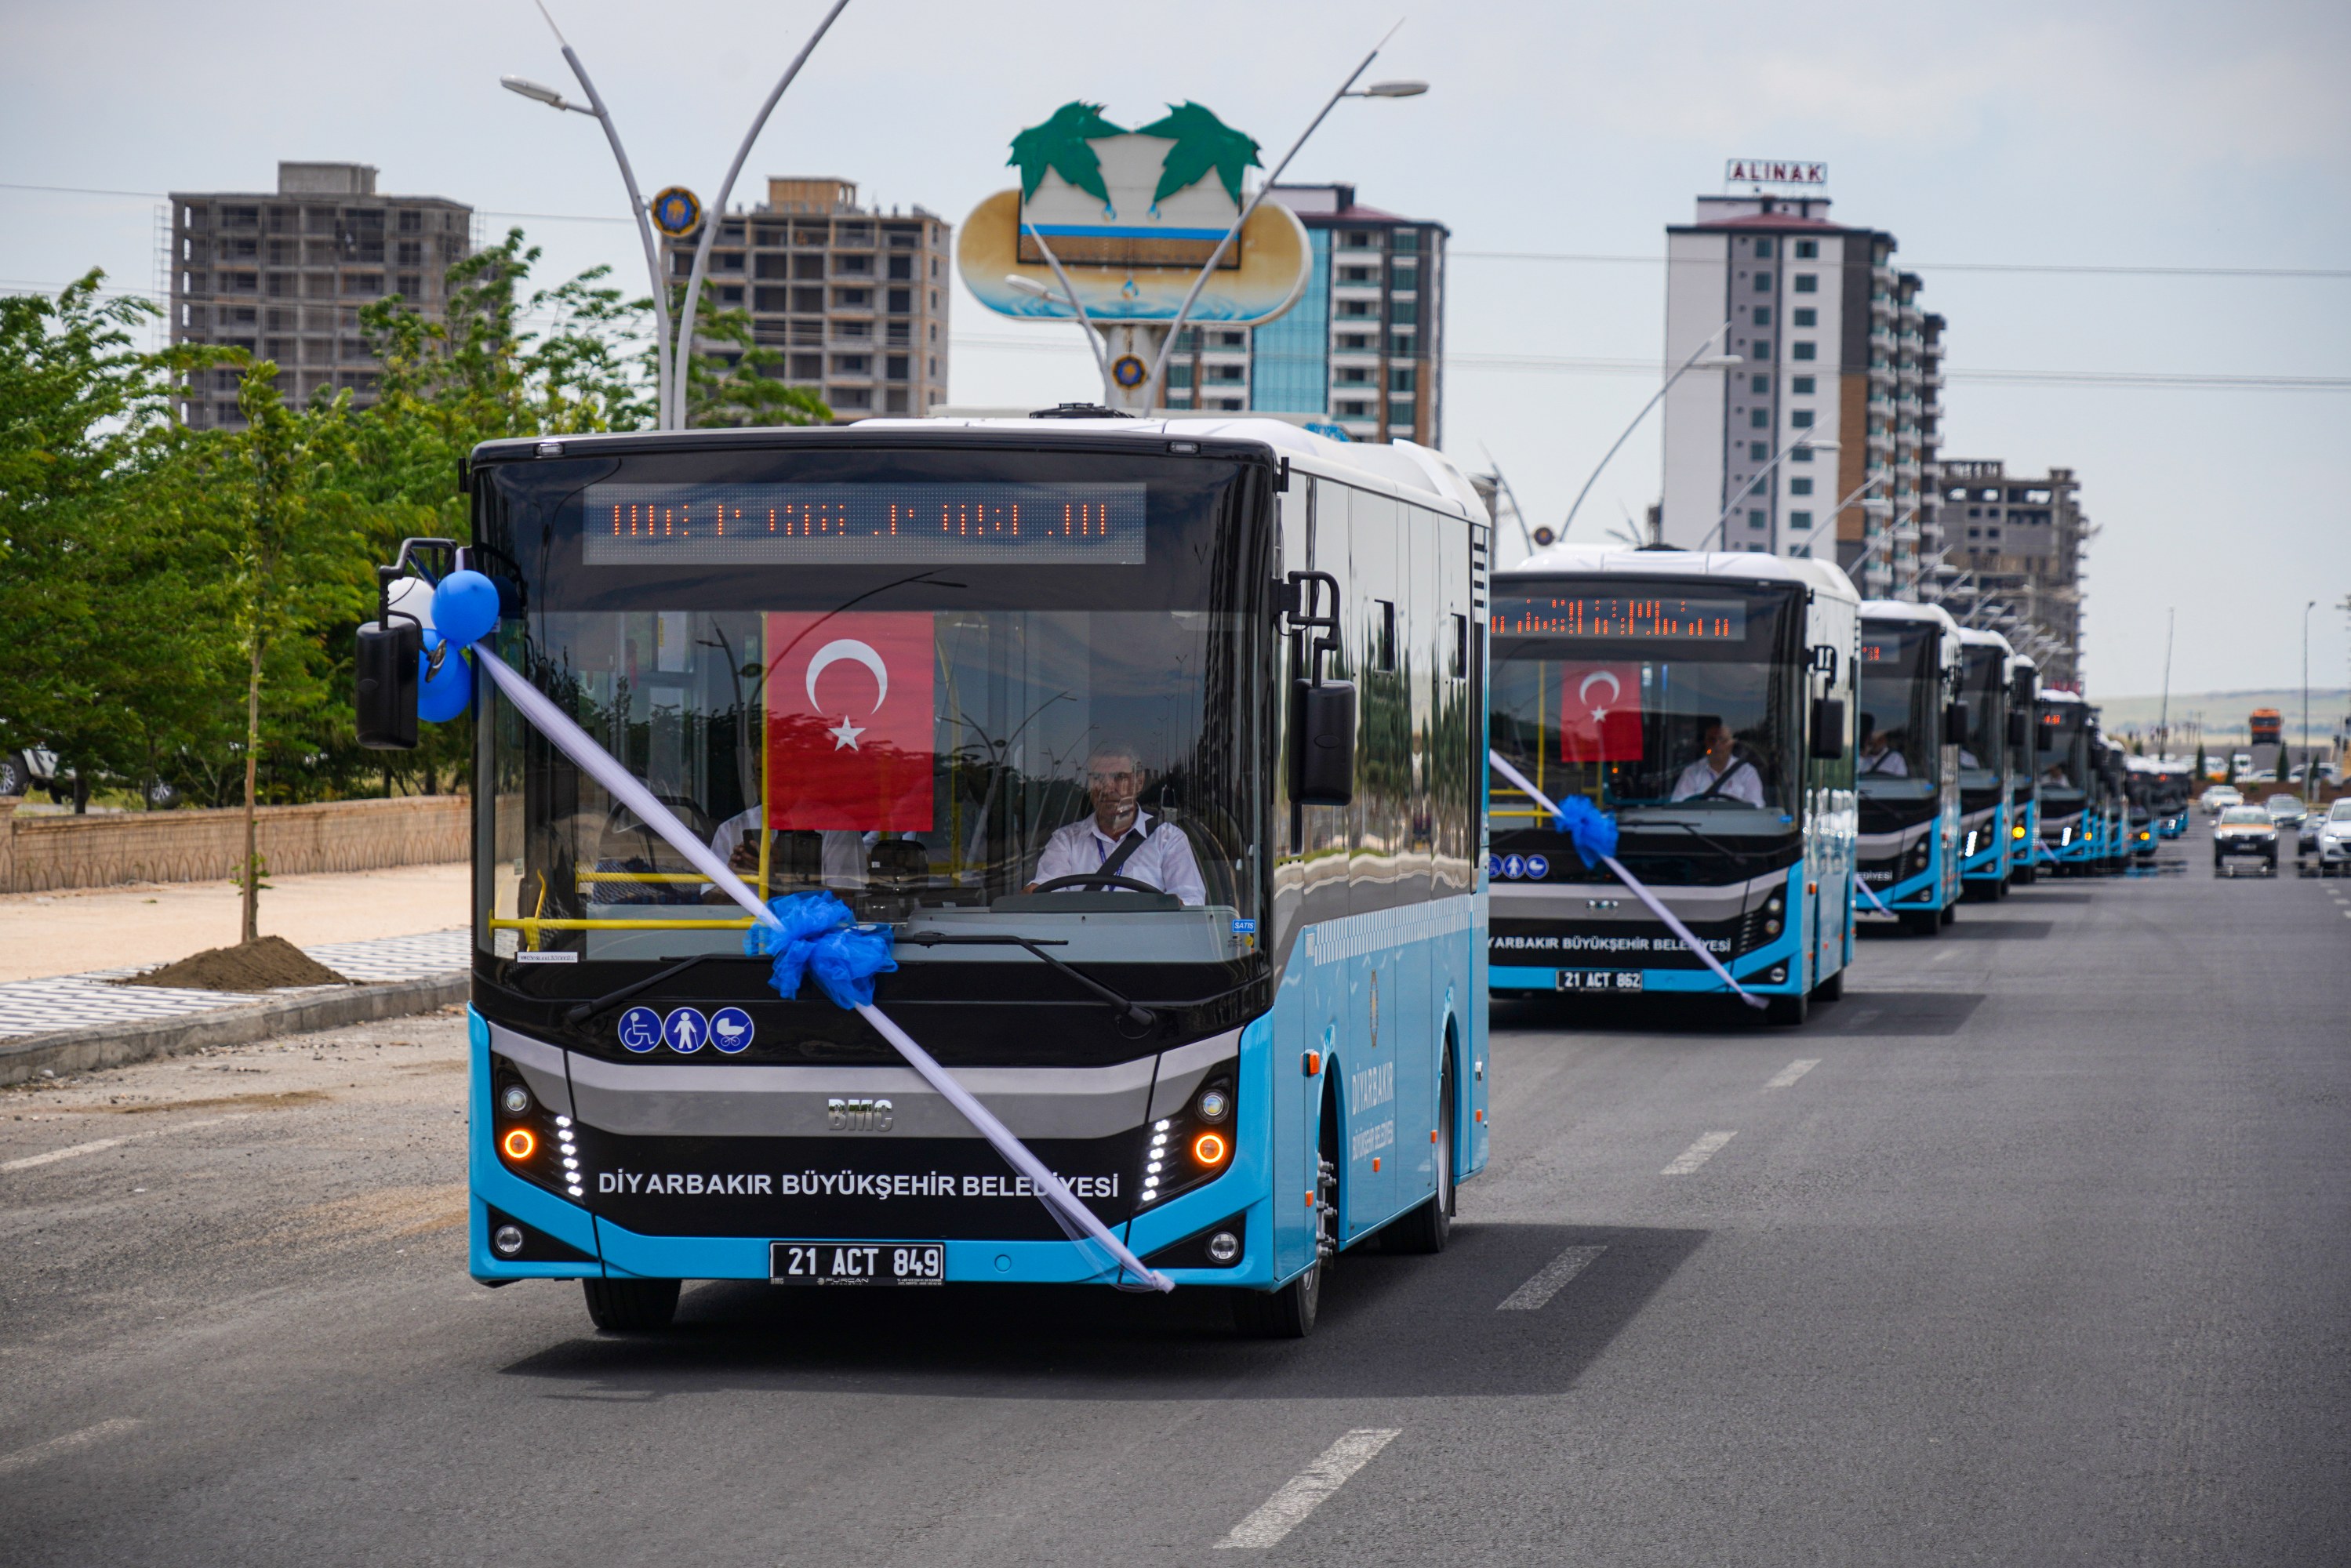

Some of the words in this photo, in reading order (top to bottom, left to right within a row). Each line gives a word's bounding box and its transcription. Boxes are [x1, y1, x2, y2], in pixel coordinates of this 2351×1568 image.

[1733, 161, 1821, 181] ALINAK
[1562, 935, 1650, 953] BÜYÜKŞEHİR
[1652, 937, 1731, 953] BELEYESİ
[1564, 972, 1580, 987] 21
[1586, 972, 1612, 987] ACT
[1352, 1061, 1393, 1116] DİYARBAKIR
[828, 1098, 893, 1131] BMC
[598, 1168, 772, 1194] DİYARBAKIR
[782, 1170, 956, 1200] BÜYÜKŞEHİR
[962, 1172, 1119, 1198] BELEDYESİ
[788, 1247, 816, 1275] 21
[831, 1248, 879, 1276] ACT
[893, 1249, 939, 1276] 849
